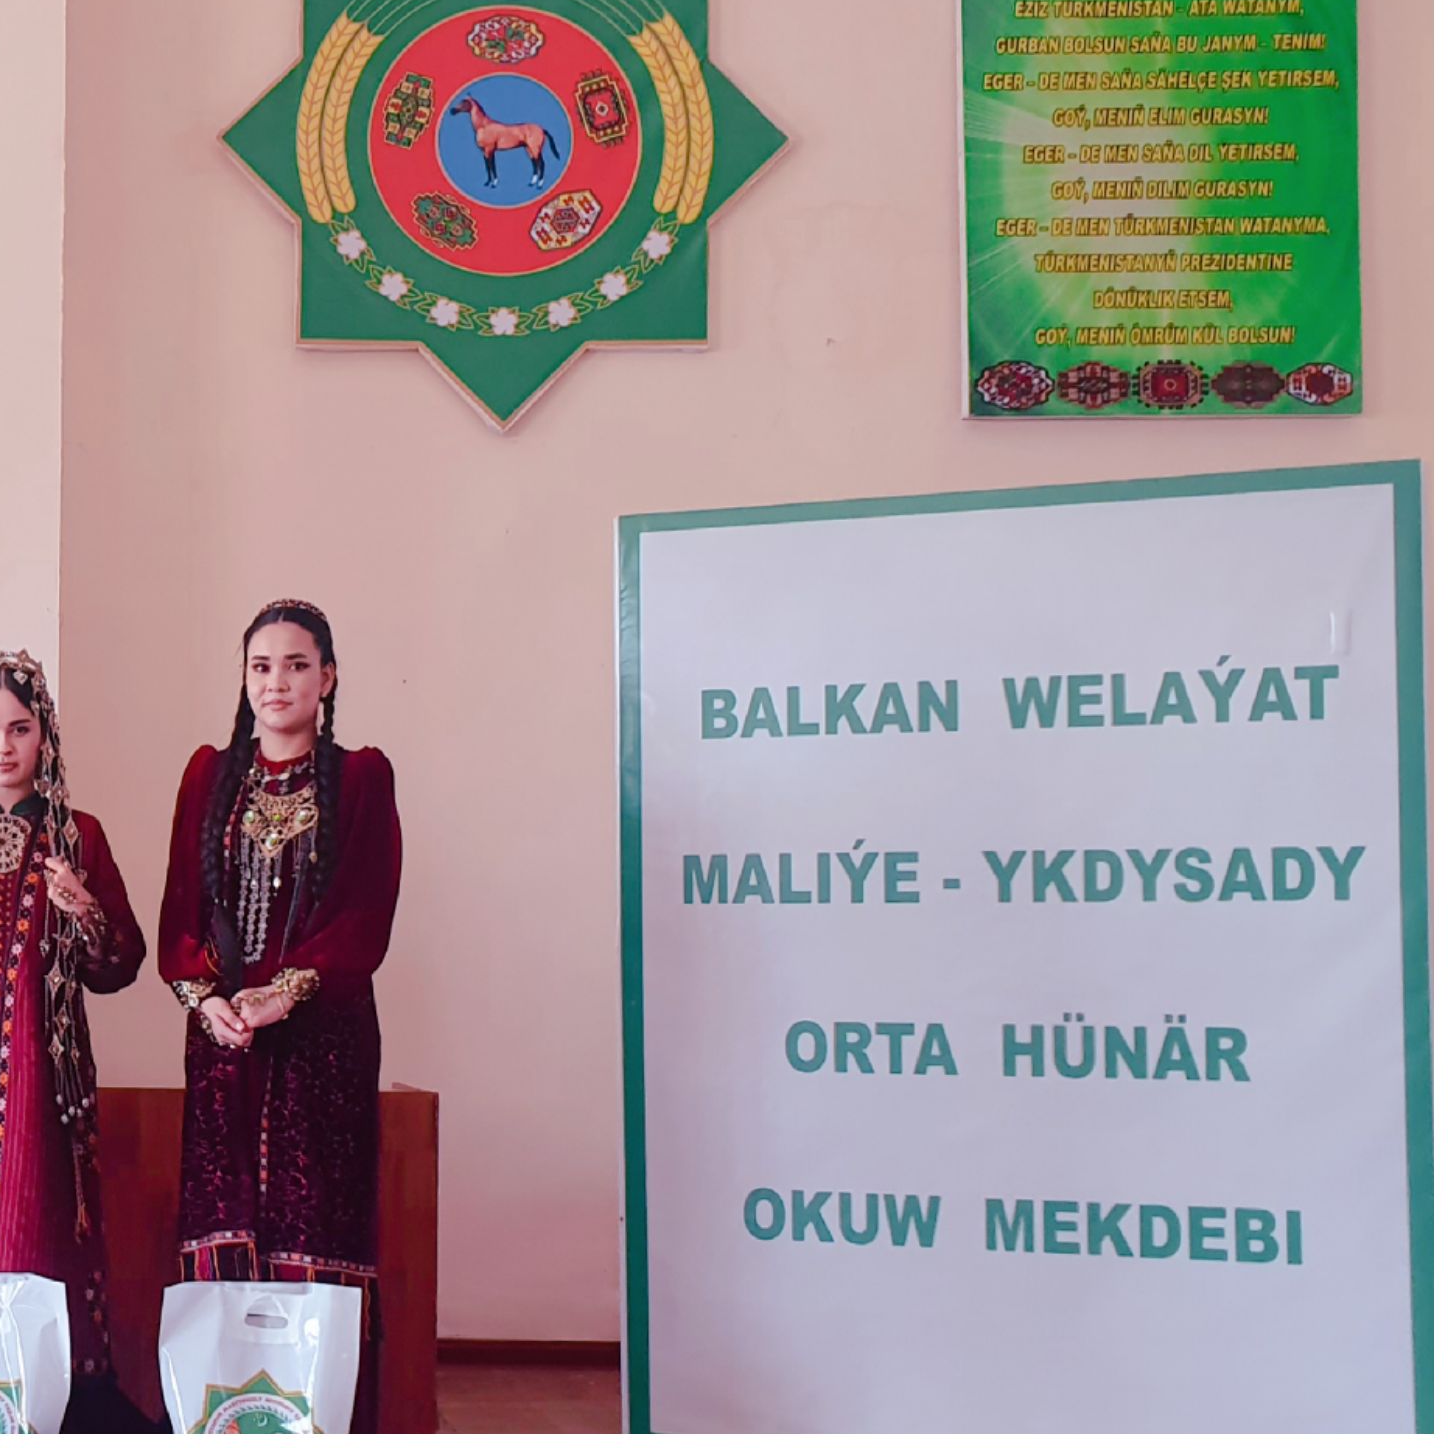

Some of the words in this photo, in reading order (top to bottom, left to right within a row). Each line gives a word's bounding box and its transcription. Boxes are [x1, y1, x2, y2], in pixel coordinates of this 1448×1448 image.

[1015, 0, 1049, 18] EZIZ
[1189, 0, 1217, 16] ATA
[996, 36, 1060, 55] GURBAN
[1063, 36, 1127, 54] BOLSUN
[1176, 35, 1198, 52] BU
[1203, 34, 1257, 52] JANYM
[1273, 33, 1326, 50] TENIM!
[983, 73, 1024, 91] EGER
[1038, 73, 1059, 90] DE
[1063, 72, 1097, 90] MEN
[1148, 107, 1185, 126] ELIM
[1190, 107, 1269, 126] GURASYN!
[1024, 145, 1065, 164] EGER
[1080, 145, 1100, 163] DE
[1104, 144, 1138, 163] MEN
[1188, 144, 1212, 162] DIL
[1147, 181, 1189, 200] DILIM
[1194, 180, 1274, 198] GURASYN!
[996, 218, 1037, 236] EGER
[1051, 218, 1072, 236] DE
[1076, 218, 1110, 236] MEN
[1240, 217, 1330, 235] WATANYMA,
[1180, 254, 1292, 271] PREZIDENTINE
[1177, 291, 1233, 312] ETSEM,
[1228, 326, 1295, 344] BOLSUN!
[701, 679, 959, 739] BALKAN
[1002, 655, 1339, 729] WELAÝAT
[683, 839, 920, 905] MALIÝE
[943, 878, 961, 889] -
[983, 845, 1366, 903] YKDYSADY
[784, 1020, 959, 1077] ORTA
[1002, 1013, 1250, 1082] HÜNÄR
[743, 1187, 941, 1248] OKUW
[984, 1197, 1303, 1266] MEKDEBI
